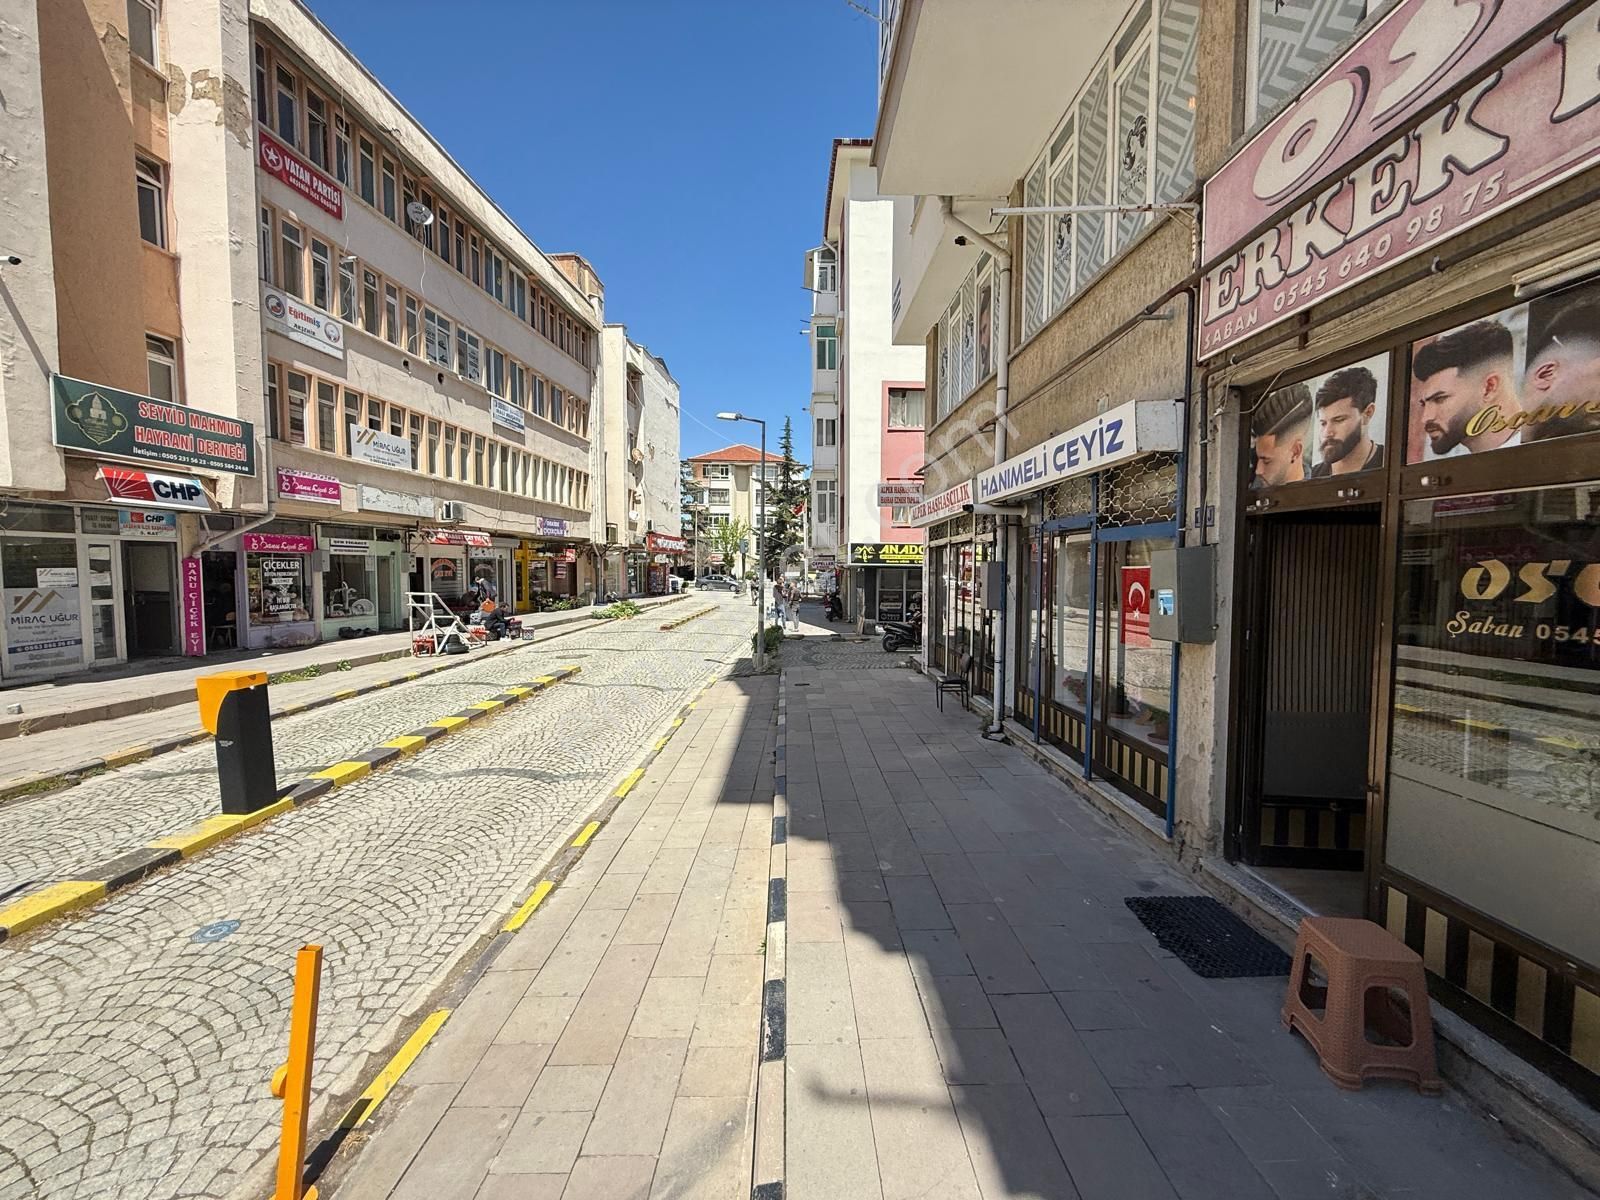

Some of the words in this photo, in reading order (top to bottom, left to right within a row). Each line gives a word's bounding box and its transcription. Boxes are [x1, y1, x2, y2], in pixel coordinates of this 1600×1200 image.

[284, 155, 311, 186] VATAN
[312, 176, 341, 206] PARTİSİ
[1204, 70, 1511, 326] ERKEK
[1273, 267, 1328, 313] 0545
[1338, 233, 1392, 279] 640
[1405, 204, 1445, 244] 98
[1458, 169, 1506, 217] 75
[138, 400, 186, 426] SEYYİD
[189, 412, 242, 438] MAHMUD
[132, 446, 158, 458] İletişim
[134, 425, 194, 452] HAYRANİ
[197, 438, 247, 461] DERNEĞİ
[980, 444, 1048, 498] HANIMELİ
[1052, 417, 1124, 475] ÇEYİZ
[153, 480, 201, 500] CHP
[145, 514, 165, 523] CHP
[188, 562, 198, 589] BANU
[263, 560, 300, 571] ÇİÇEKLER
[11, 615, 47, 625] MİRAÇ
[49, 612, 79, 623] UĞUR
[1446, 610, 1523, 638] Şaban
